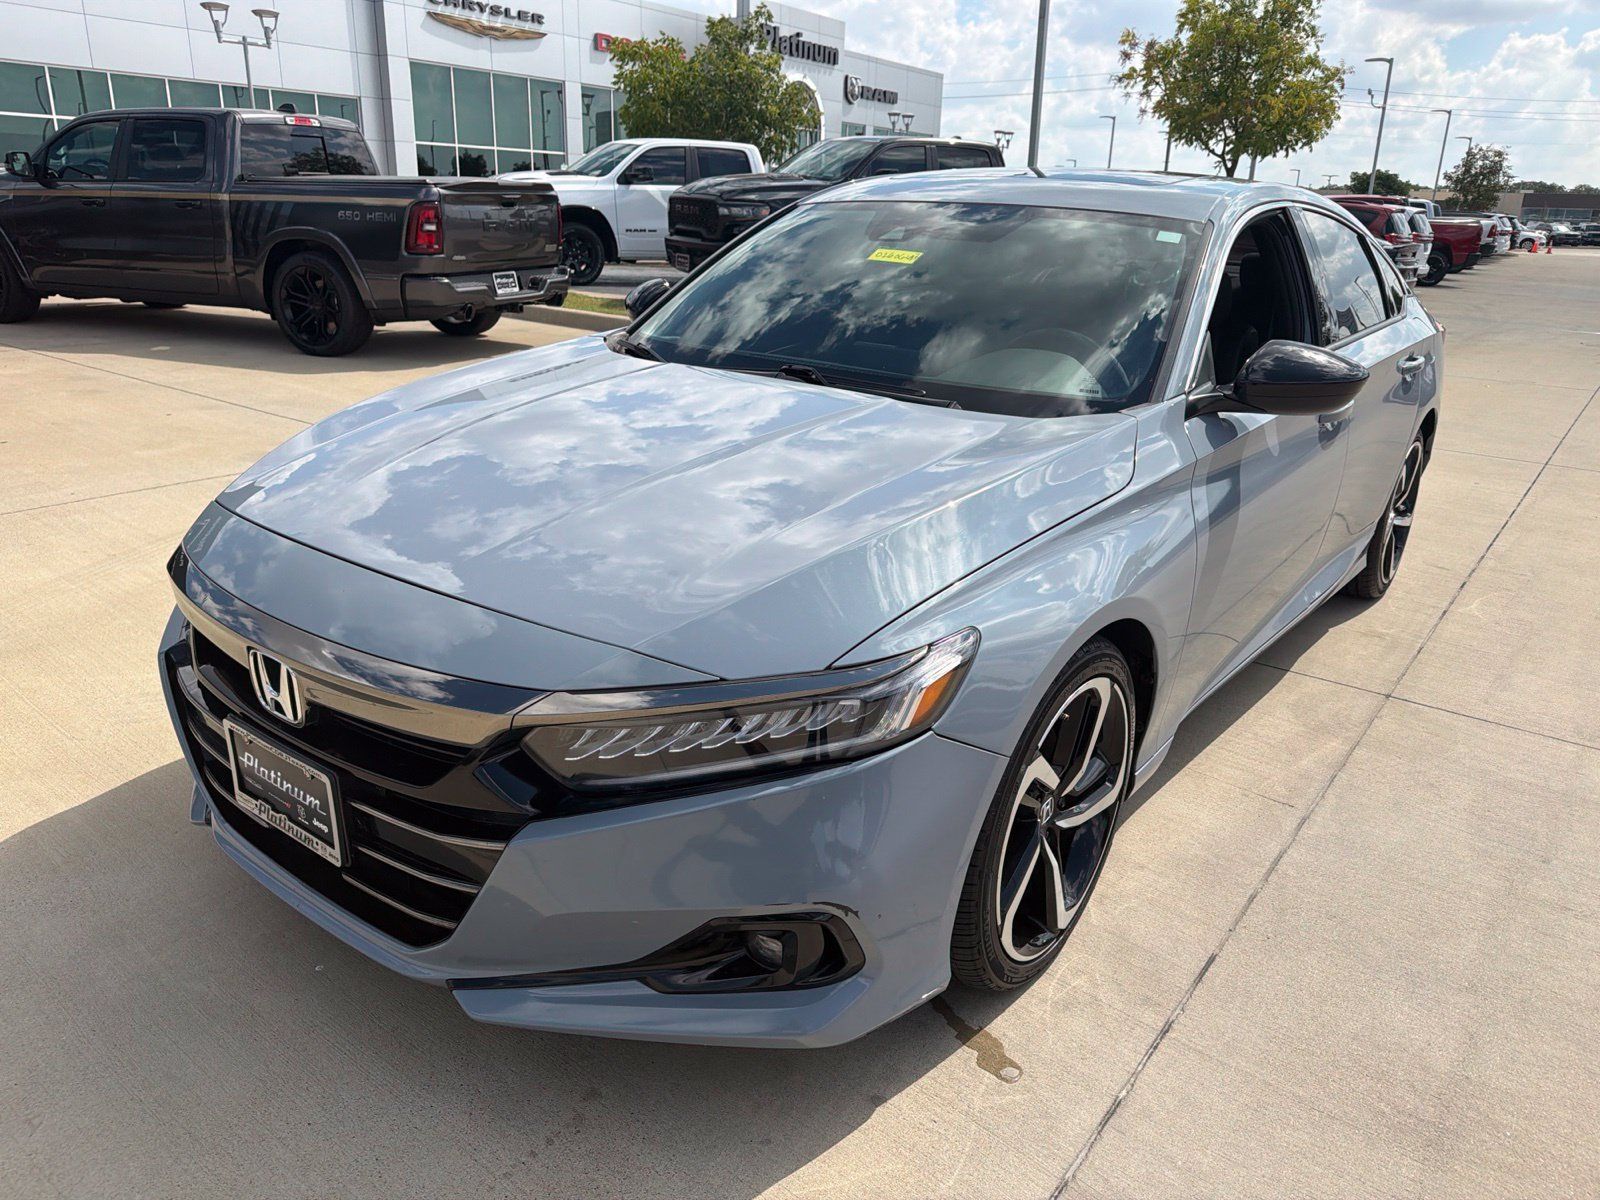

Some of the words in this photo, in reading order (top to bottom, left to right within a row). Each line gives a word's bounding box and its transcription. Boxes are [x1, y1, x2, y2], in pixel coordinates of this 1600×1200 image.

[761, 24, 839, 66] Platinum
[861, 86, 898, 105] RAM
[338, 211, 361, 221] 650
[366, 211, 397, 222] HEMI
[239, 751, 327, 816] Platinum
[258, 801, 319, 851] Platinum
